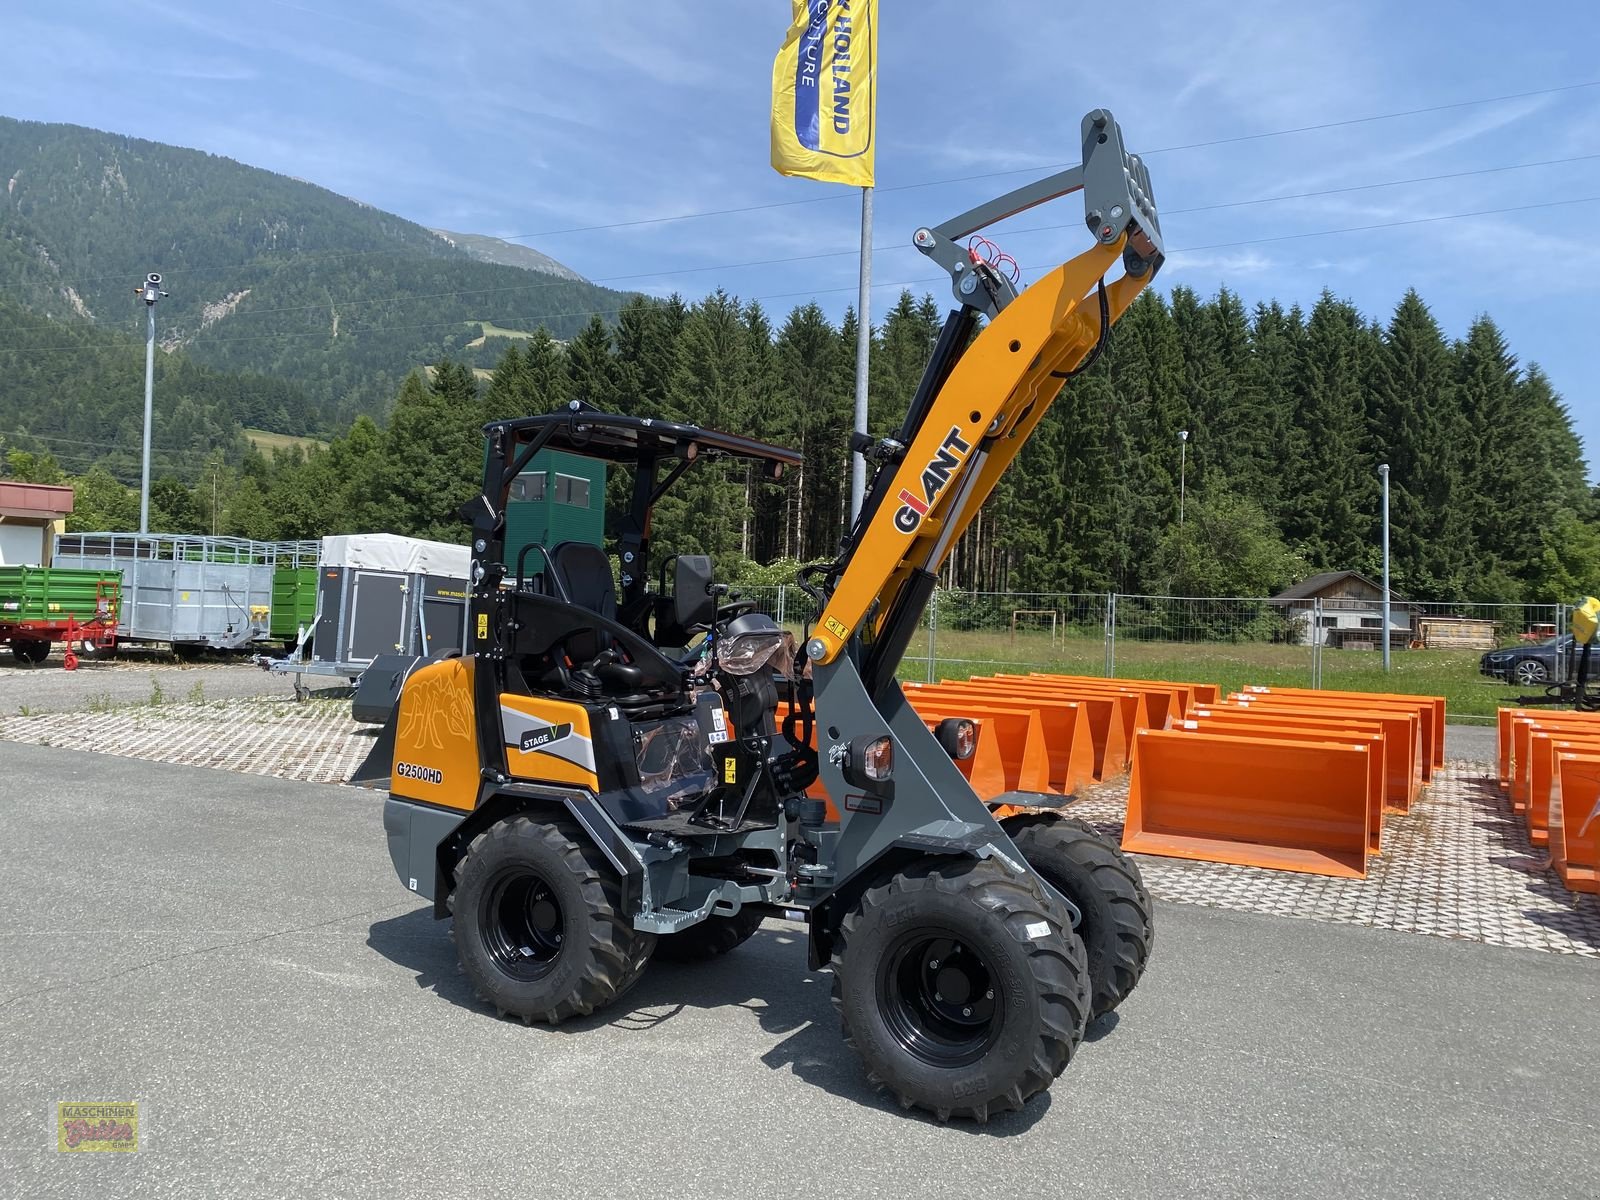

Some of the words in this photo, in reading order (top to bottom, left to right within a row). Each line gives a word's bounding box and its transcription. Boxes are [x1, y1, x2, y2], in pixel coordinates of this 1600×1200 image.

[832, 15, 852, 135] HOLLAND
[523, 734, 549, 748] STAGE
[397, 762, 443, 785] G2500HD
